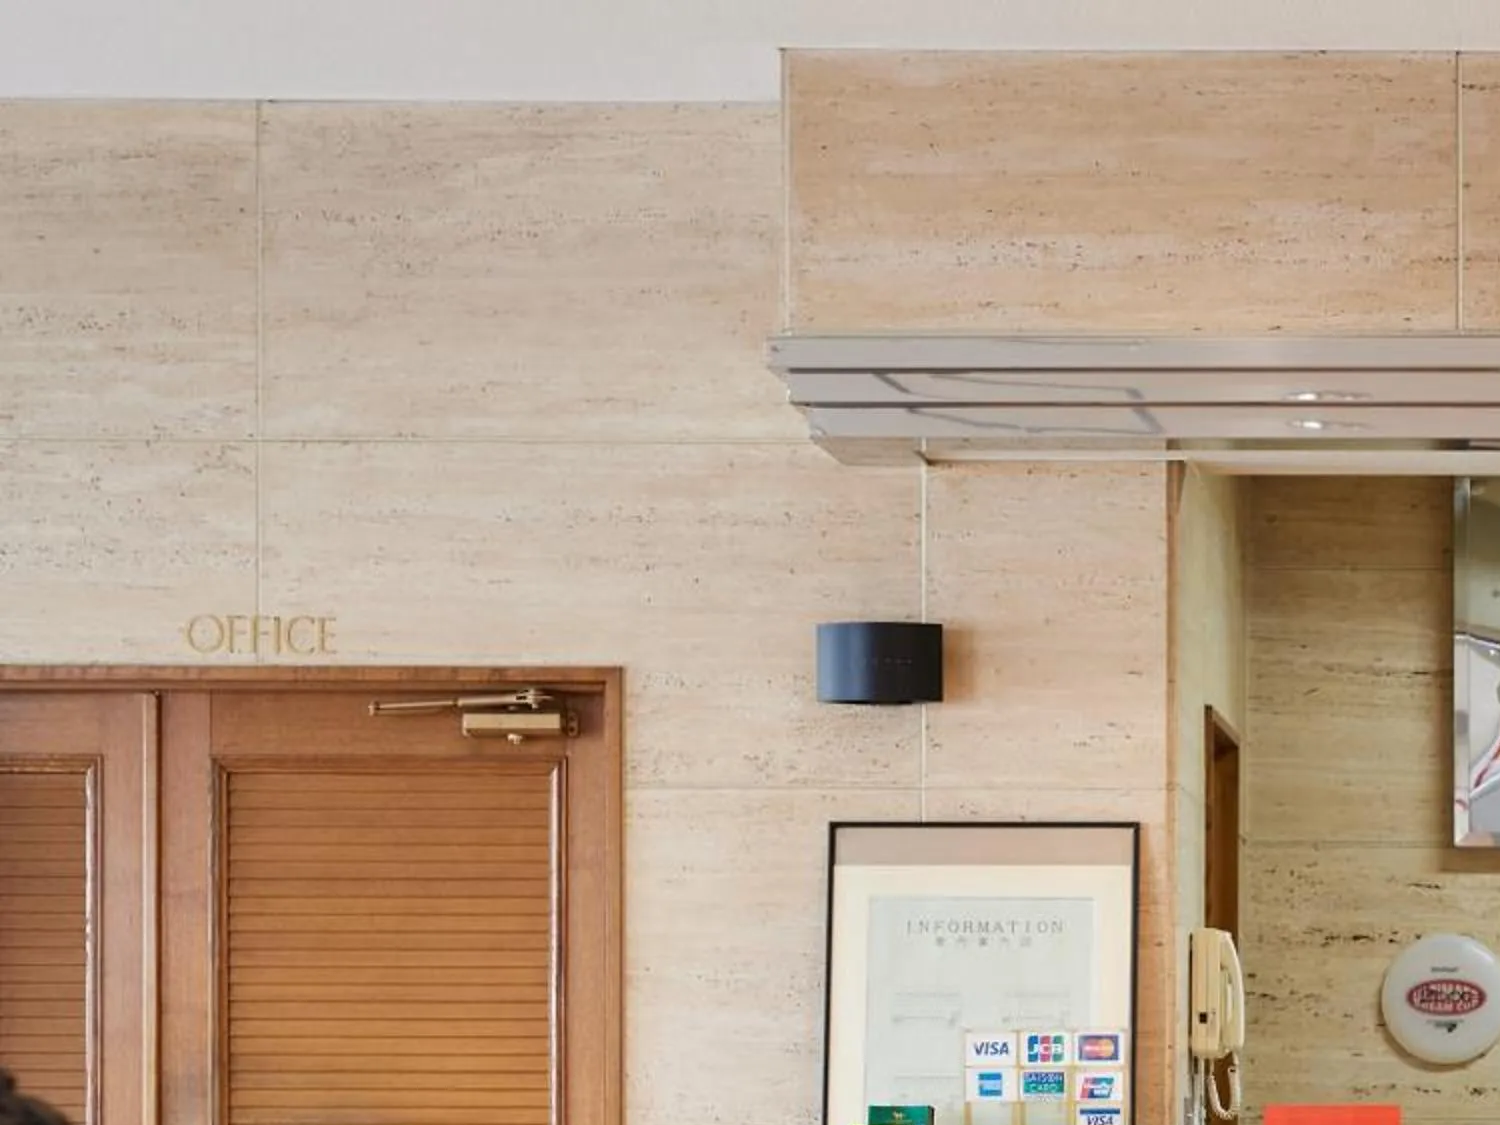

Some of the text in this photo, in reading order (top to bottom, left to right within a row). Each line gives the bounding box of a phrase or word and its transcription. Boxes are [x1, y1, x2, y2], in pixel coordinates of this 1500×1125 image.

[187, 613, 338, 654] OFFICE
[906, 919, 1064, 935] INFORMATION
[973, 1041, 1010, 1056] VISA
